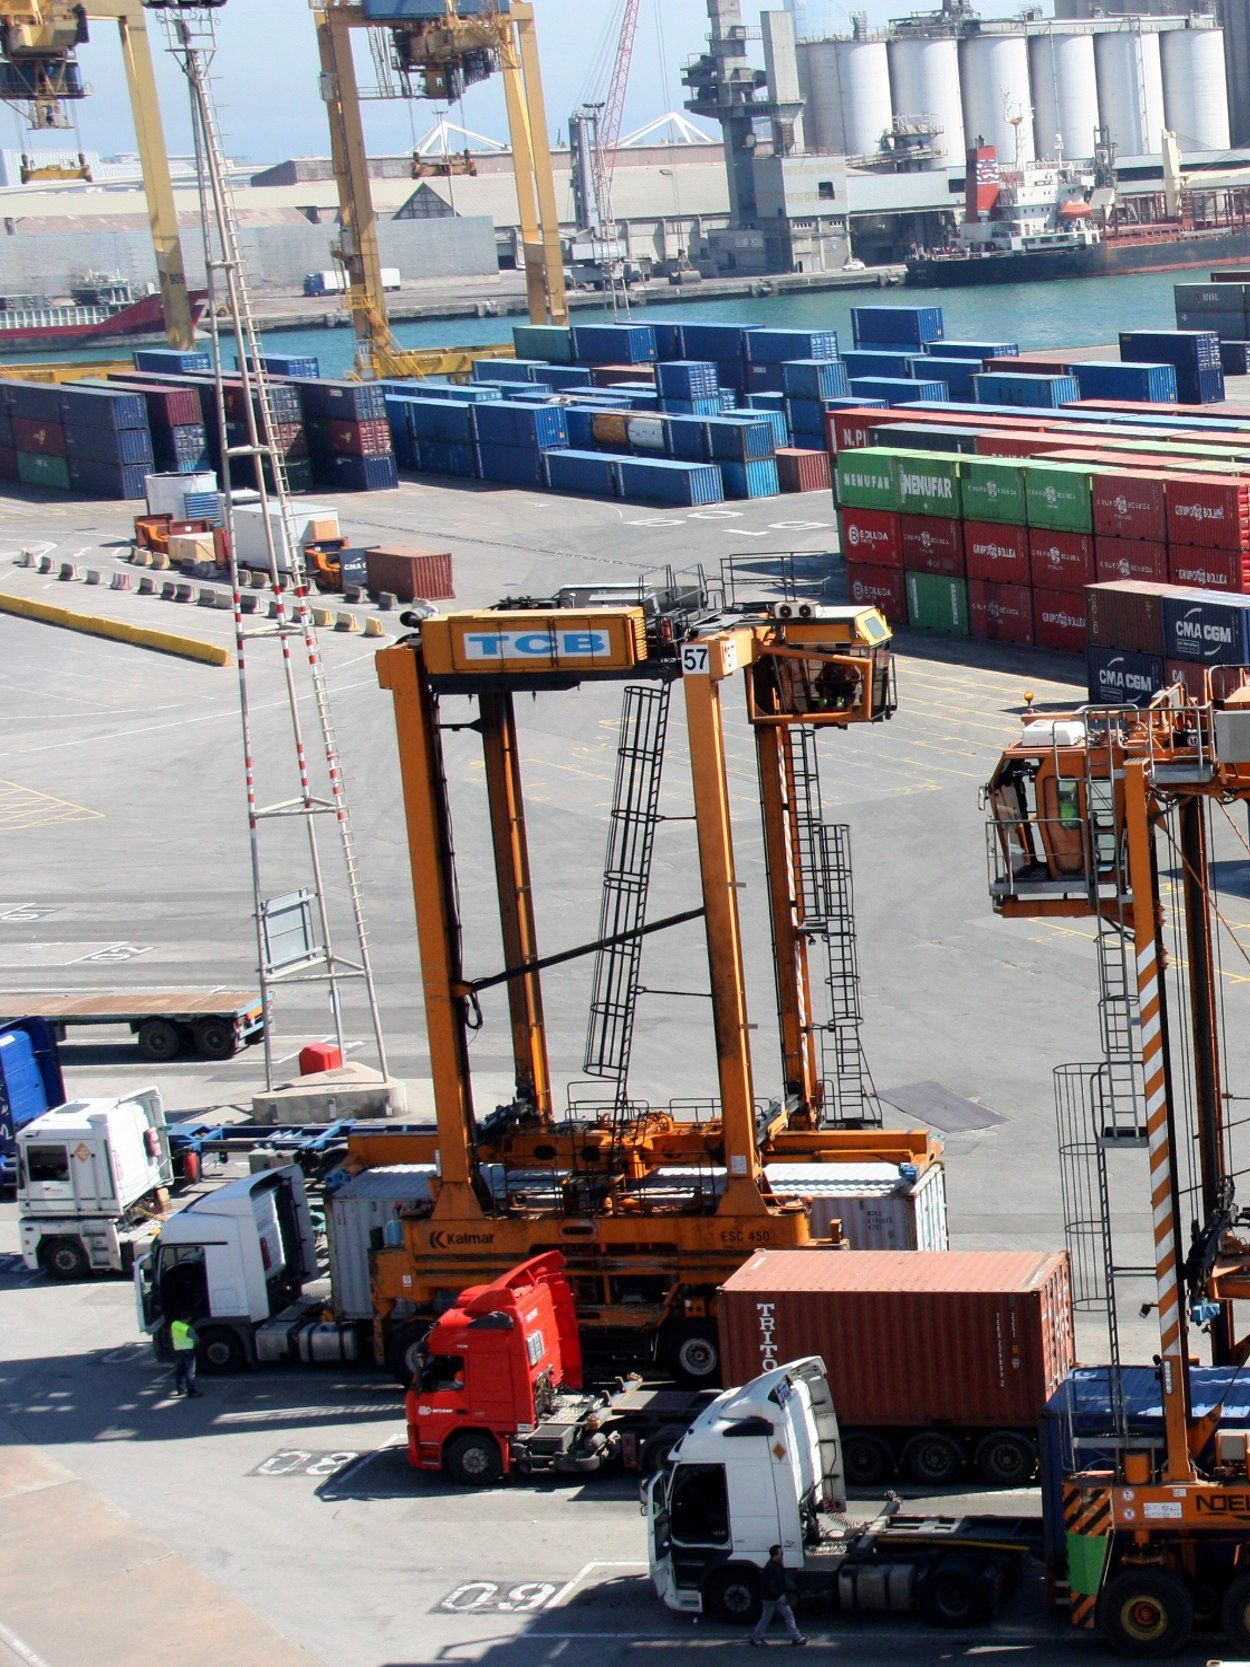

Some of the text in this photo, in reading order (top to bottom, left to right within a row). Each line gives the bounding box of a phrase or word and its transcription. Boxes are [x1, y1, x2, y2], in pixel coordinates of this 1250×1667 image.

[844, 474, 889, 490] NENUFAR
[903, 474, 952, 498] NENUFAR
[1176, 620, 1231, 643] CMA CGM
[468, 634, 605, 655] TCB
[684, 648, 708, 670] 57
[1100, 669, 1152, 691] CMA CGM
[448, 1232, 495, 1246] Kalmar
[721, 1230, 770, 1242] ESC 450
[757, 1303, 778, 1376] TRITO
[256, 1450, 359, 1475] 08
[441, 1582, 556, 1612] 09
